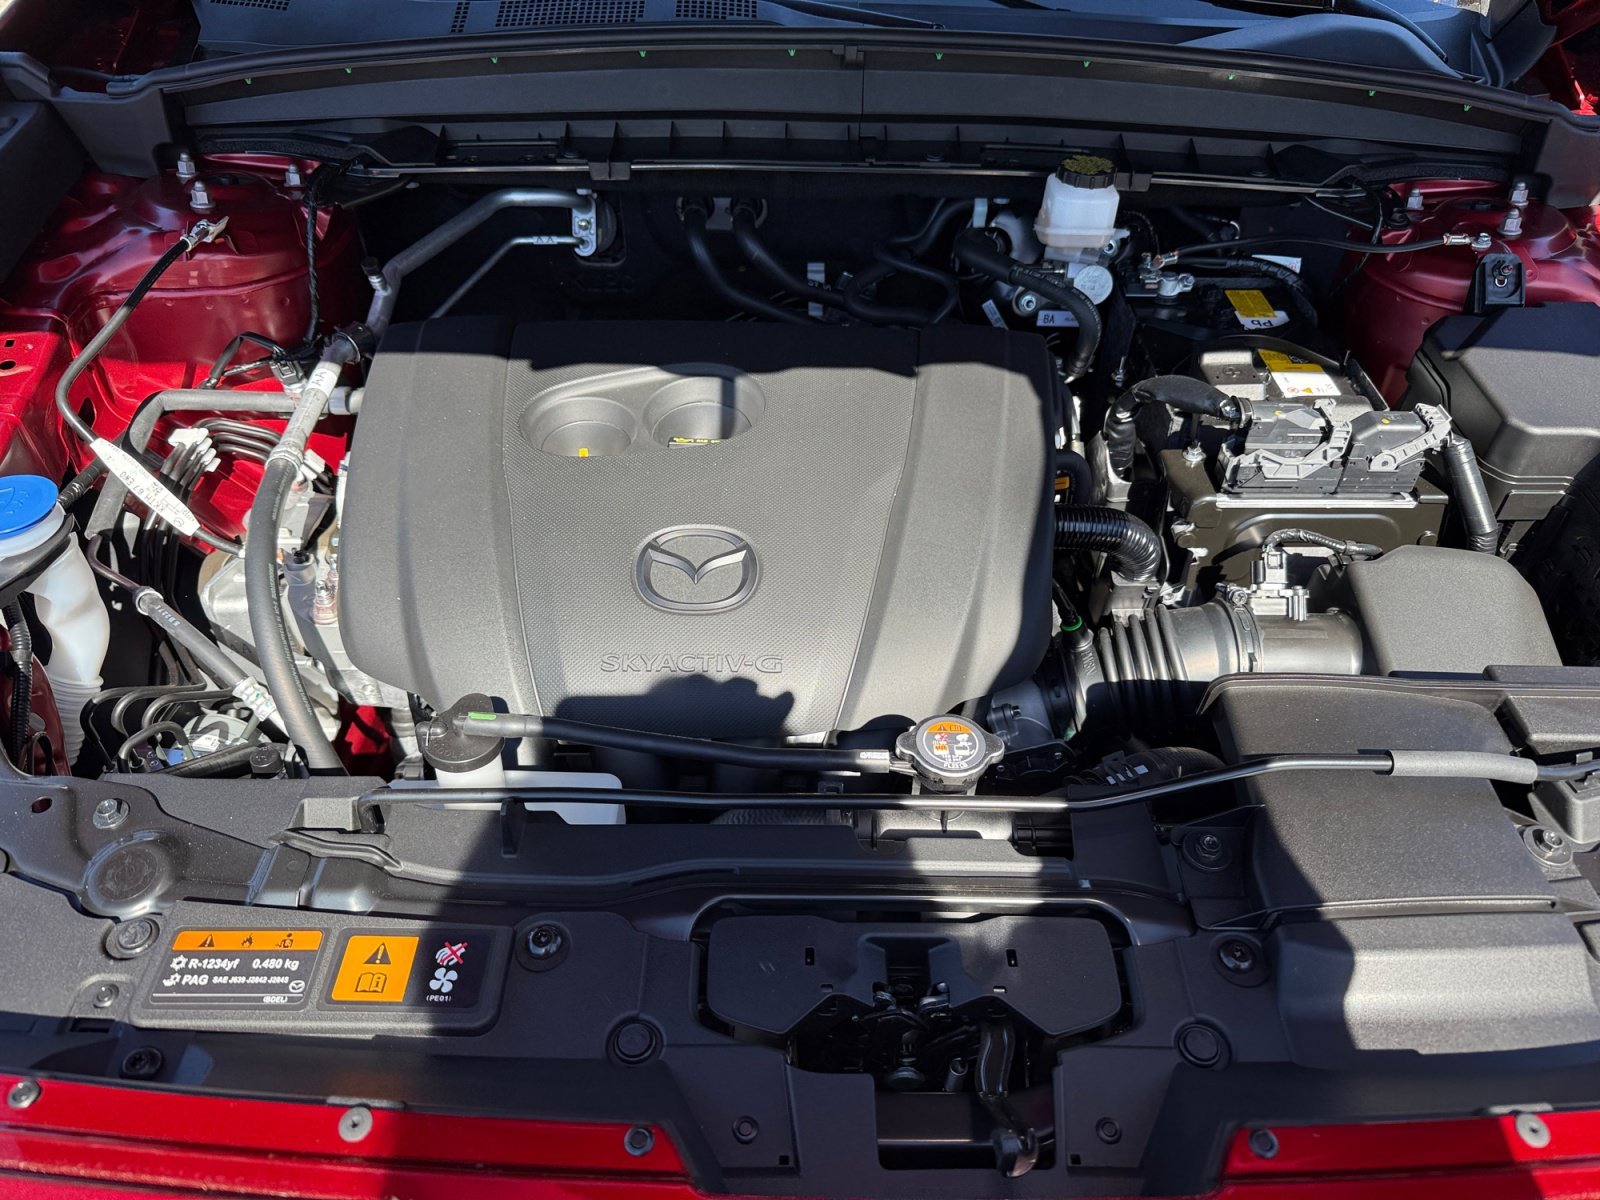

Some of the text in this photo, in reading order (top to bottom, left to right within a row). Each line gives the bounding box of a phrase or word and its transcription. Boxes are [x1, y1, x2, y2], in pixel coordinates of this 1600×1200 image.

[1043, 314, 1055, 325] BA
[1251, 319, 1274, 327] Pb
[600, 653, 783, 674] SKYACTIV-G
[188, 958, 299, 971] R-1234yf 0.480 kg
[181, 974, 209, 985] PAG
[212, 976, 229, 984] SAE
[426, 994, 451, 1002] (PE01)
